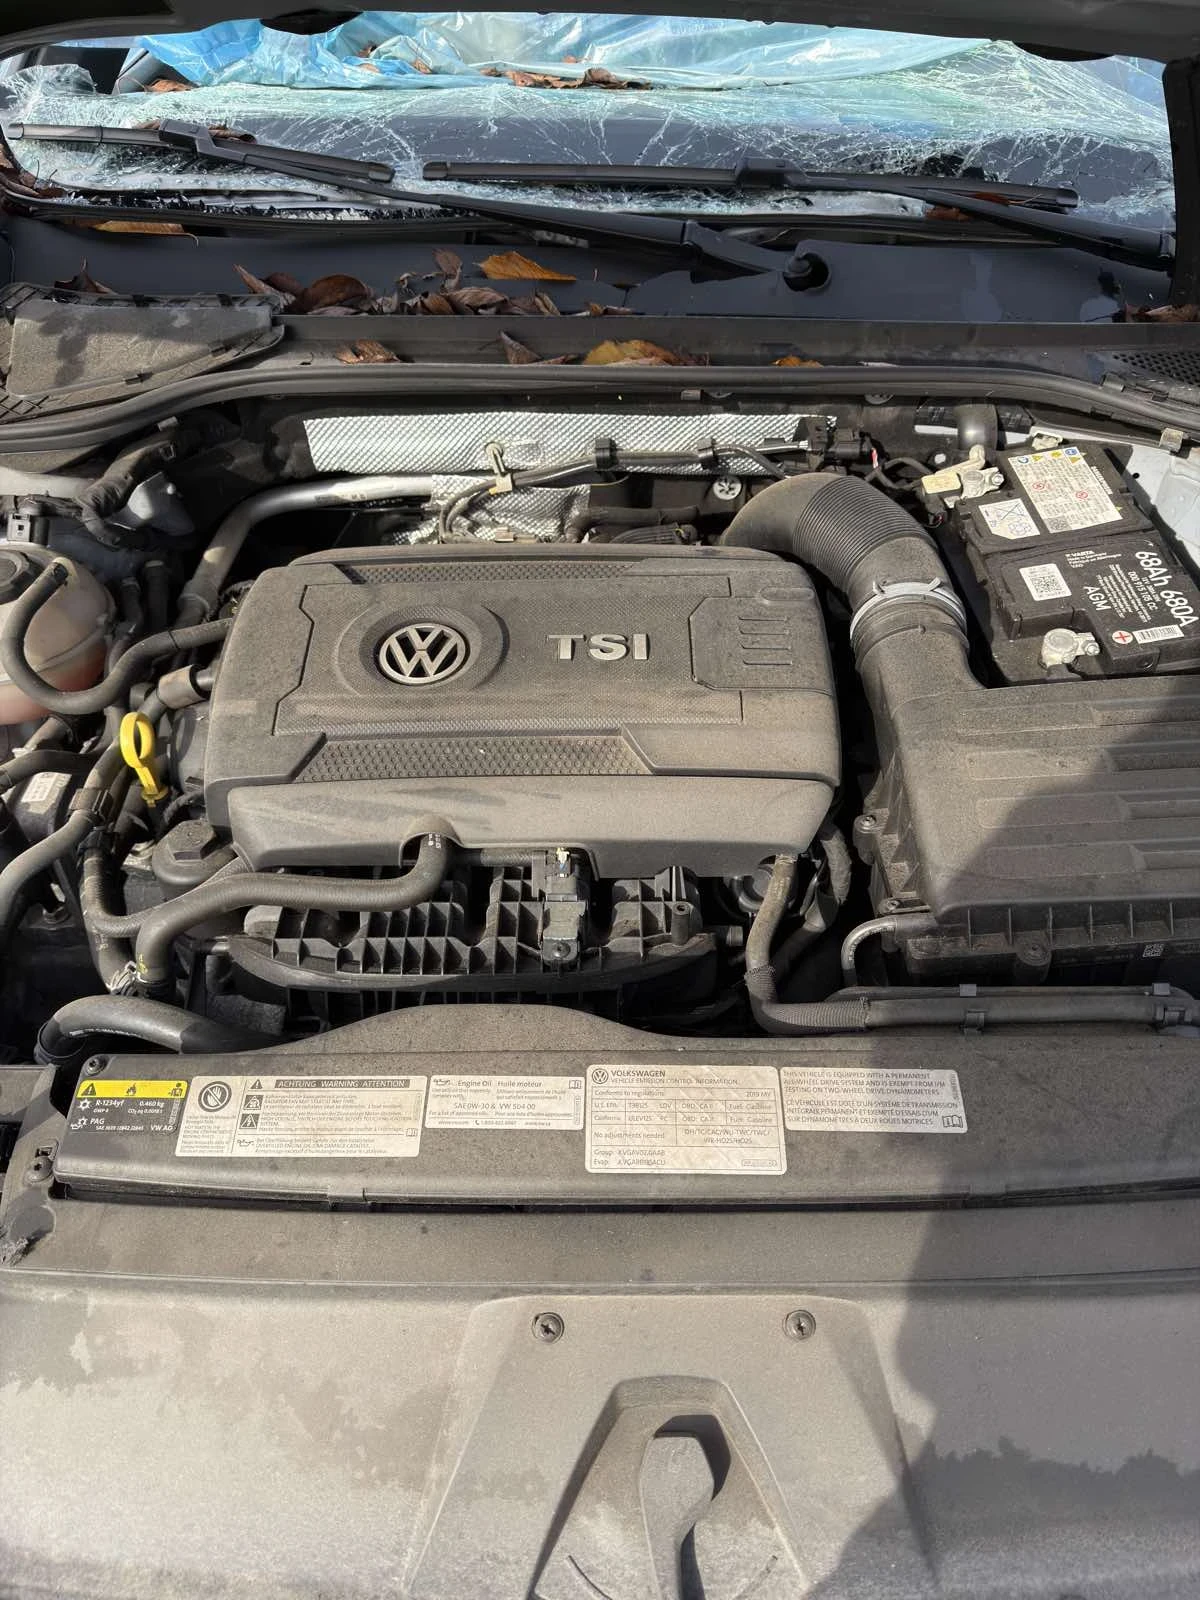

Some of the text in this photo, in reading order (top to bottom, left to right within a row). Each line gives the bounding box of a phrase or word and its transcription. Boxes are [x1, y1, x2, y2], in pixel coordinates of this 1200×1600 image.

[1084, 586, 1112, 611] AGM
[1136, 552, 1199, 627] 68Ah 680A
[547, 633, 649, 660] TSI
[278, 1080, 405, 1088] ACHTUNG WARNING ATTENTION
[458, 1080, 481, 1088] Engine
